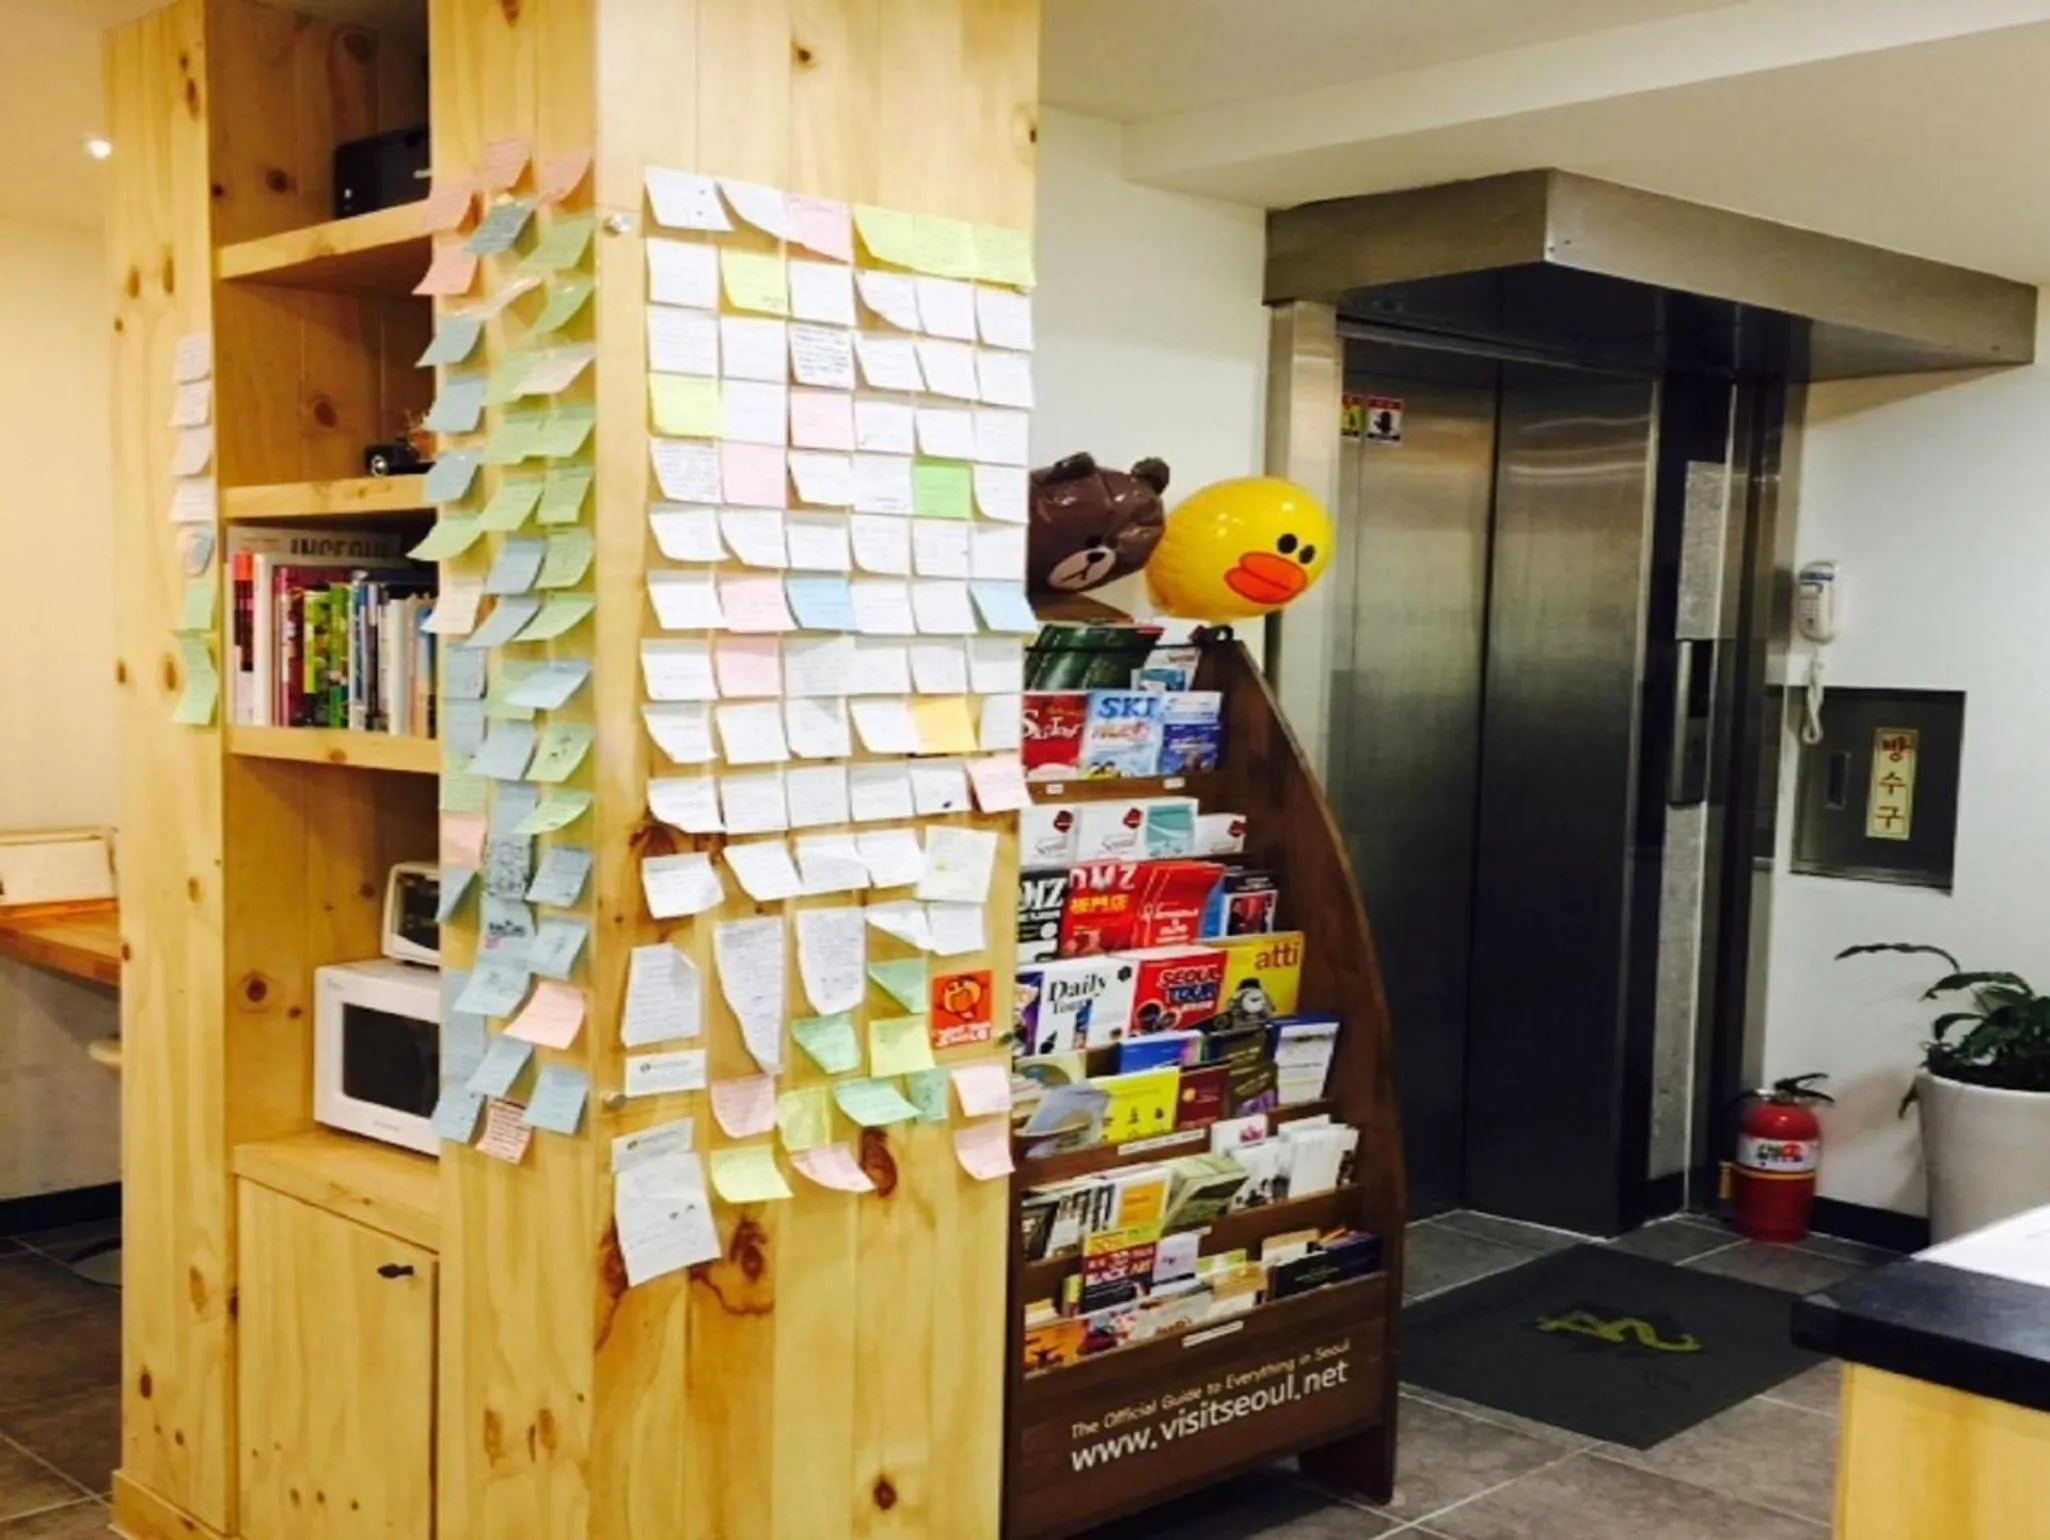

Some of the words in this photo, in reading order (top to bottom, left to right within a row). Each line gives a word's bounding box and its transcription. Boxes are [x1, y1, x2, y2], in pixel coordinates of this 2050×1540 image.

[1099, 697, 1159, 719] SKI
[1876, 735, 1914, 830] 방수구
[1255, 942, 1301, 970] atti
[1048, 973, 1107, 1003] Daily
[1072, 1421, 1099, 1439] The
[1103, 1400, 1157, 1428] Official
[1207, 1381, 1222, 1395] to
[1226, 1358, 1296, 1389] Everything
[1314, 1338, 1350, 1361] Seoul
[1072, 1361, 1350, 1472] www.visitseoul.net
